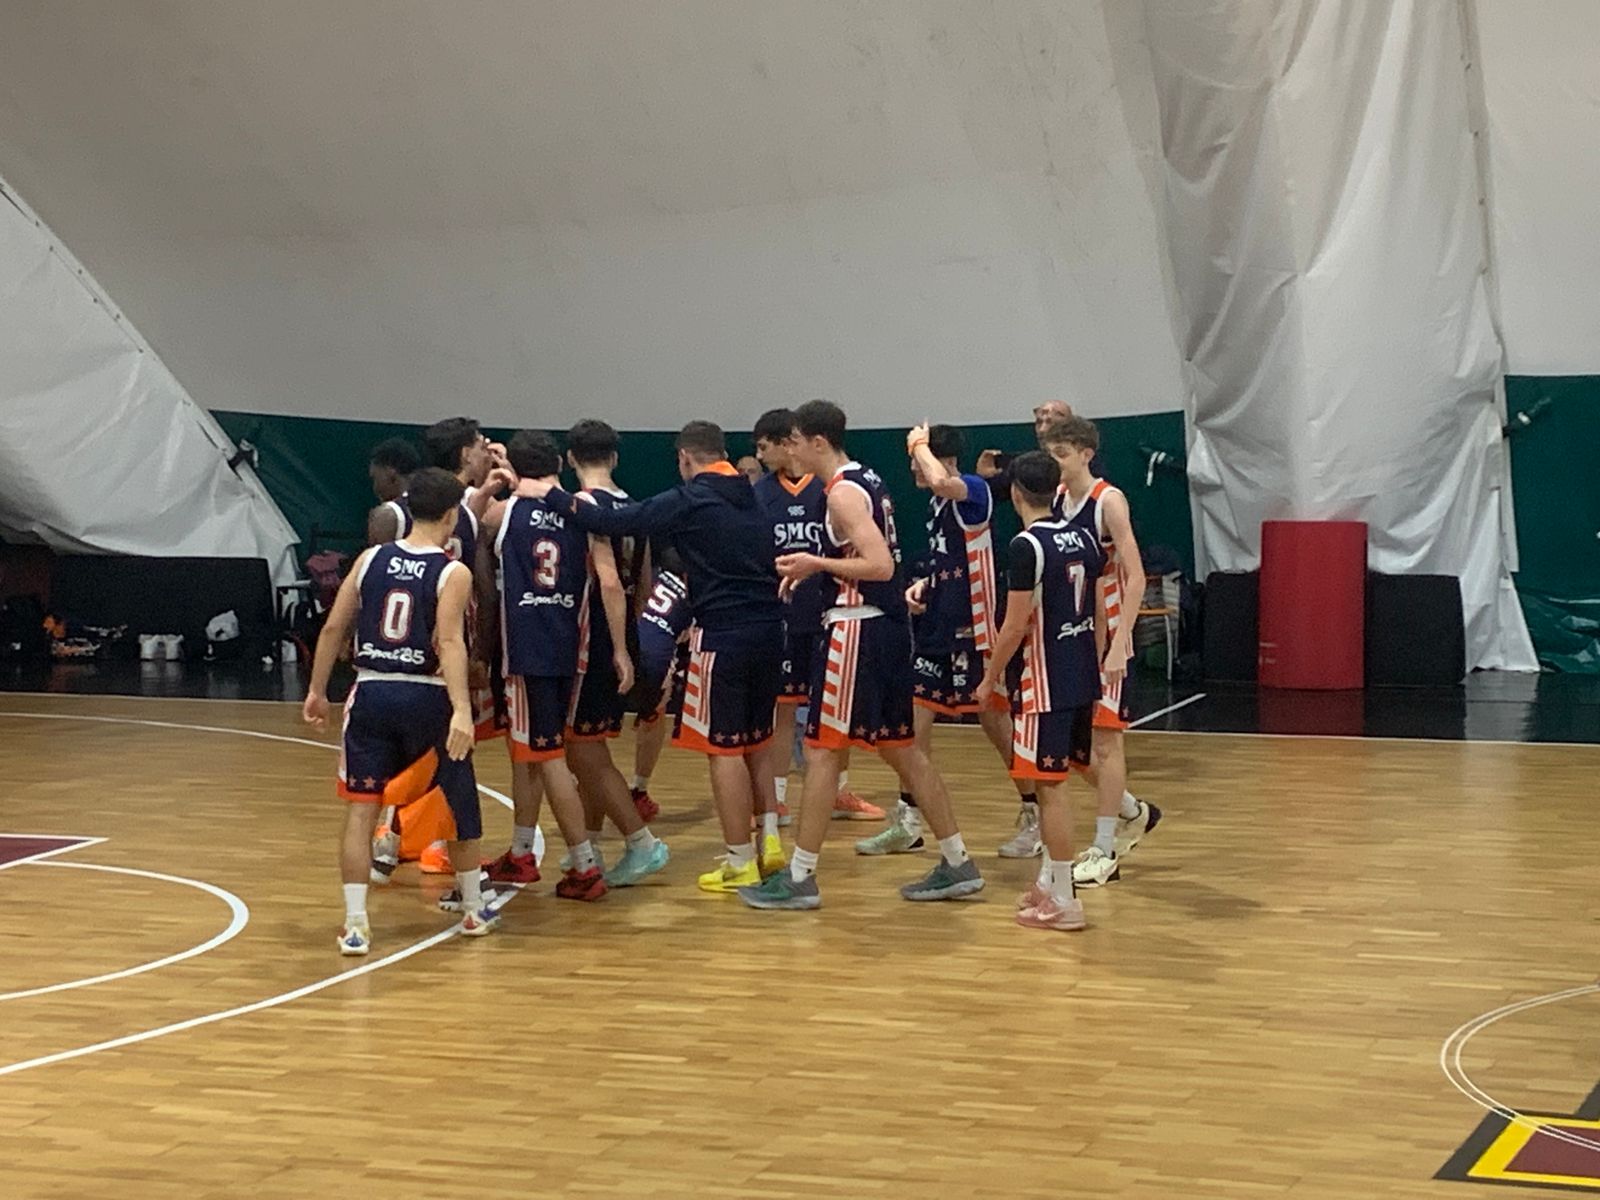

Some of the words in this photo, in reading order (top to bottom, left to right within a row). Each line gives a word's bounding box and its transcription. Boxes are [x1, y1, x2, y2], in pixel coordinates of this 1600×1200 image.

[529, 504, 565, 529] SMG
[774, 521, 823, 551] SMG
[1053, 531, 1085, 552] SMG
[387, 556, 427, 579] SMG
[535, 540, 559, 587] 3
[648, 583, 678, 613] 5
[1068, 563, 1086, 613] 7
[382, 590, 413, 640] 0
